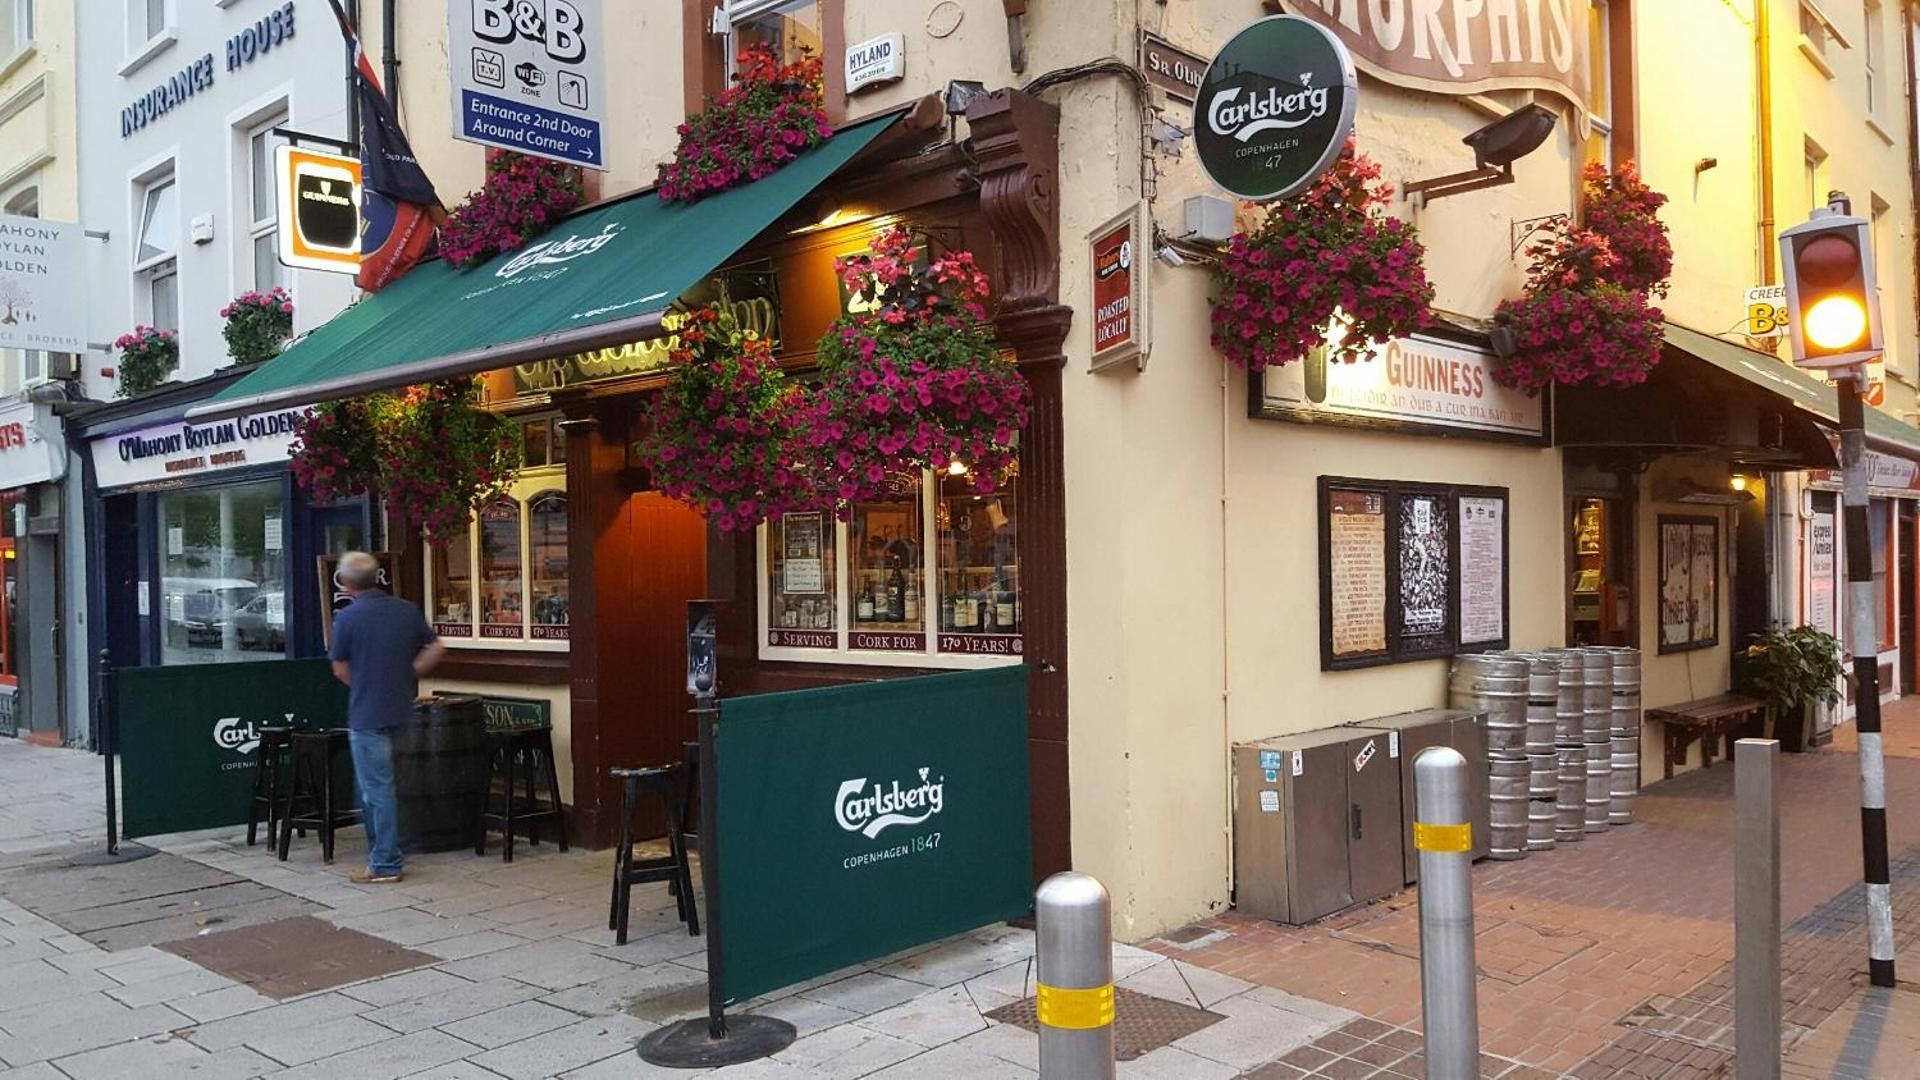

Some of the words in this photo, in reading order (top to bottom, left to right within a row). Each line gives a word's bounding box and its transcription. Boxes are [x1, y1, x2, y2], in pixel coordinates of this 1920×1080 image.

[472, 0, 586, 64] B&B
[121, 53, 214, 137] INSURANCE
[226, 1, 295, 71] HOUSE
[850, 42, 891, 70] HYLAND
[521, 86, 541, 98] ZONE
[1208, 72, 1330, 142] Carlsberg
[471, 98, 531, 125] Entrance
[533, 113, 558, 131] 2nd
[561, 121, 593, 139] Door
[472, 119, 524, 142] Around
[526, 131, 570, 151] Corner
[1234, 138, 1299, 158] COPENHAGEN
[0, 242, 44, 255] YLAN
[496, 223, 620, 278] Carlsberg
[0, 260, 47, 274] LDEN
[1098, 296, 1129, 323] ROASTED
[1098, 317, 1128, 342] LOCALLY
[1386, 341, 1484, 399] GUINNESS
[783, 631, 833, 646] SERVING
[857, 635, 890, 648] CORK
[893, 636, 917, 649] FOR
[942, 637, 961, 649] 170
[963, 637, 1009, 653] YEARS!
[834, 767, 944, 839] Carlsberg
[843, 845, 909, 869] COPENHAGEN
[910, 832, 941, 853] 1847
